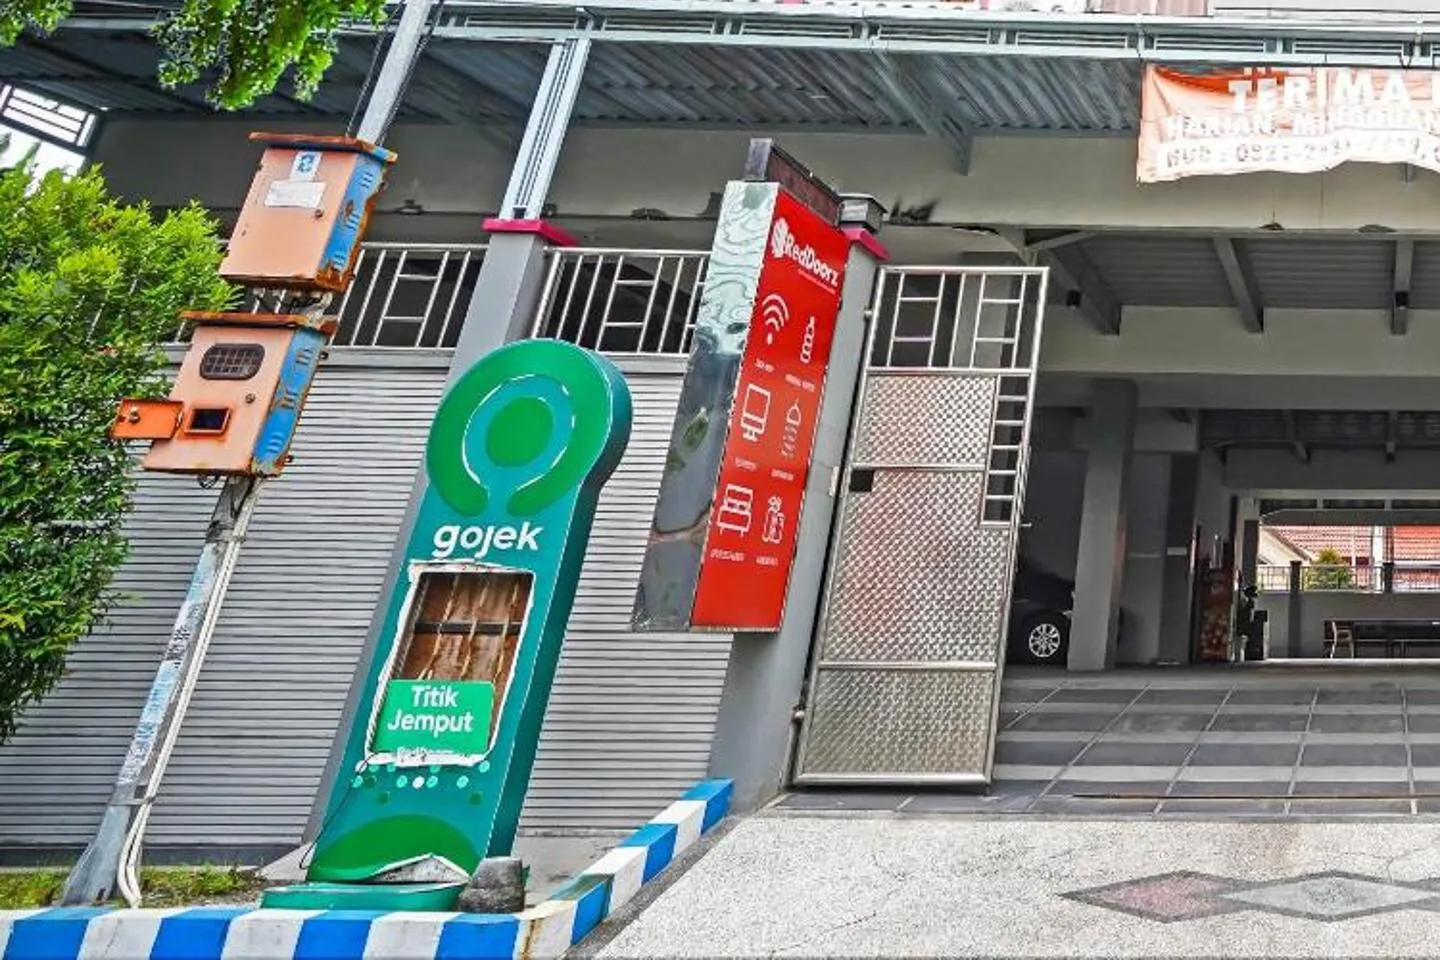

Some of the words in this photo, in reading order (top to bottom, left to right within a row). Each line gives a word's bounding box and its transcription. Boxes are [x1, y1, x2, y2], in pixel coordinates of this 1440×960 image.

[1228, 67, 1413, 114] TERIMA
[784, 231, 839, 288] RedDoorz
[431, 521, 544, 559] gojek
[411, 685, 459, 708] Titik
[387, 709, 474, 739] Jemput
